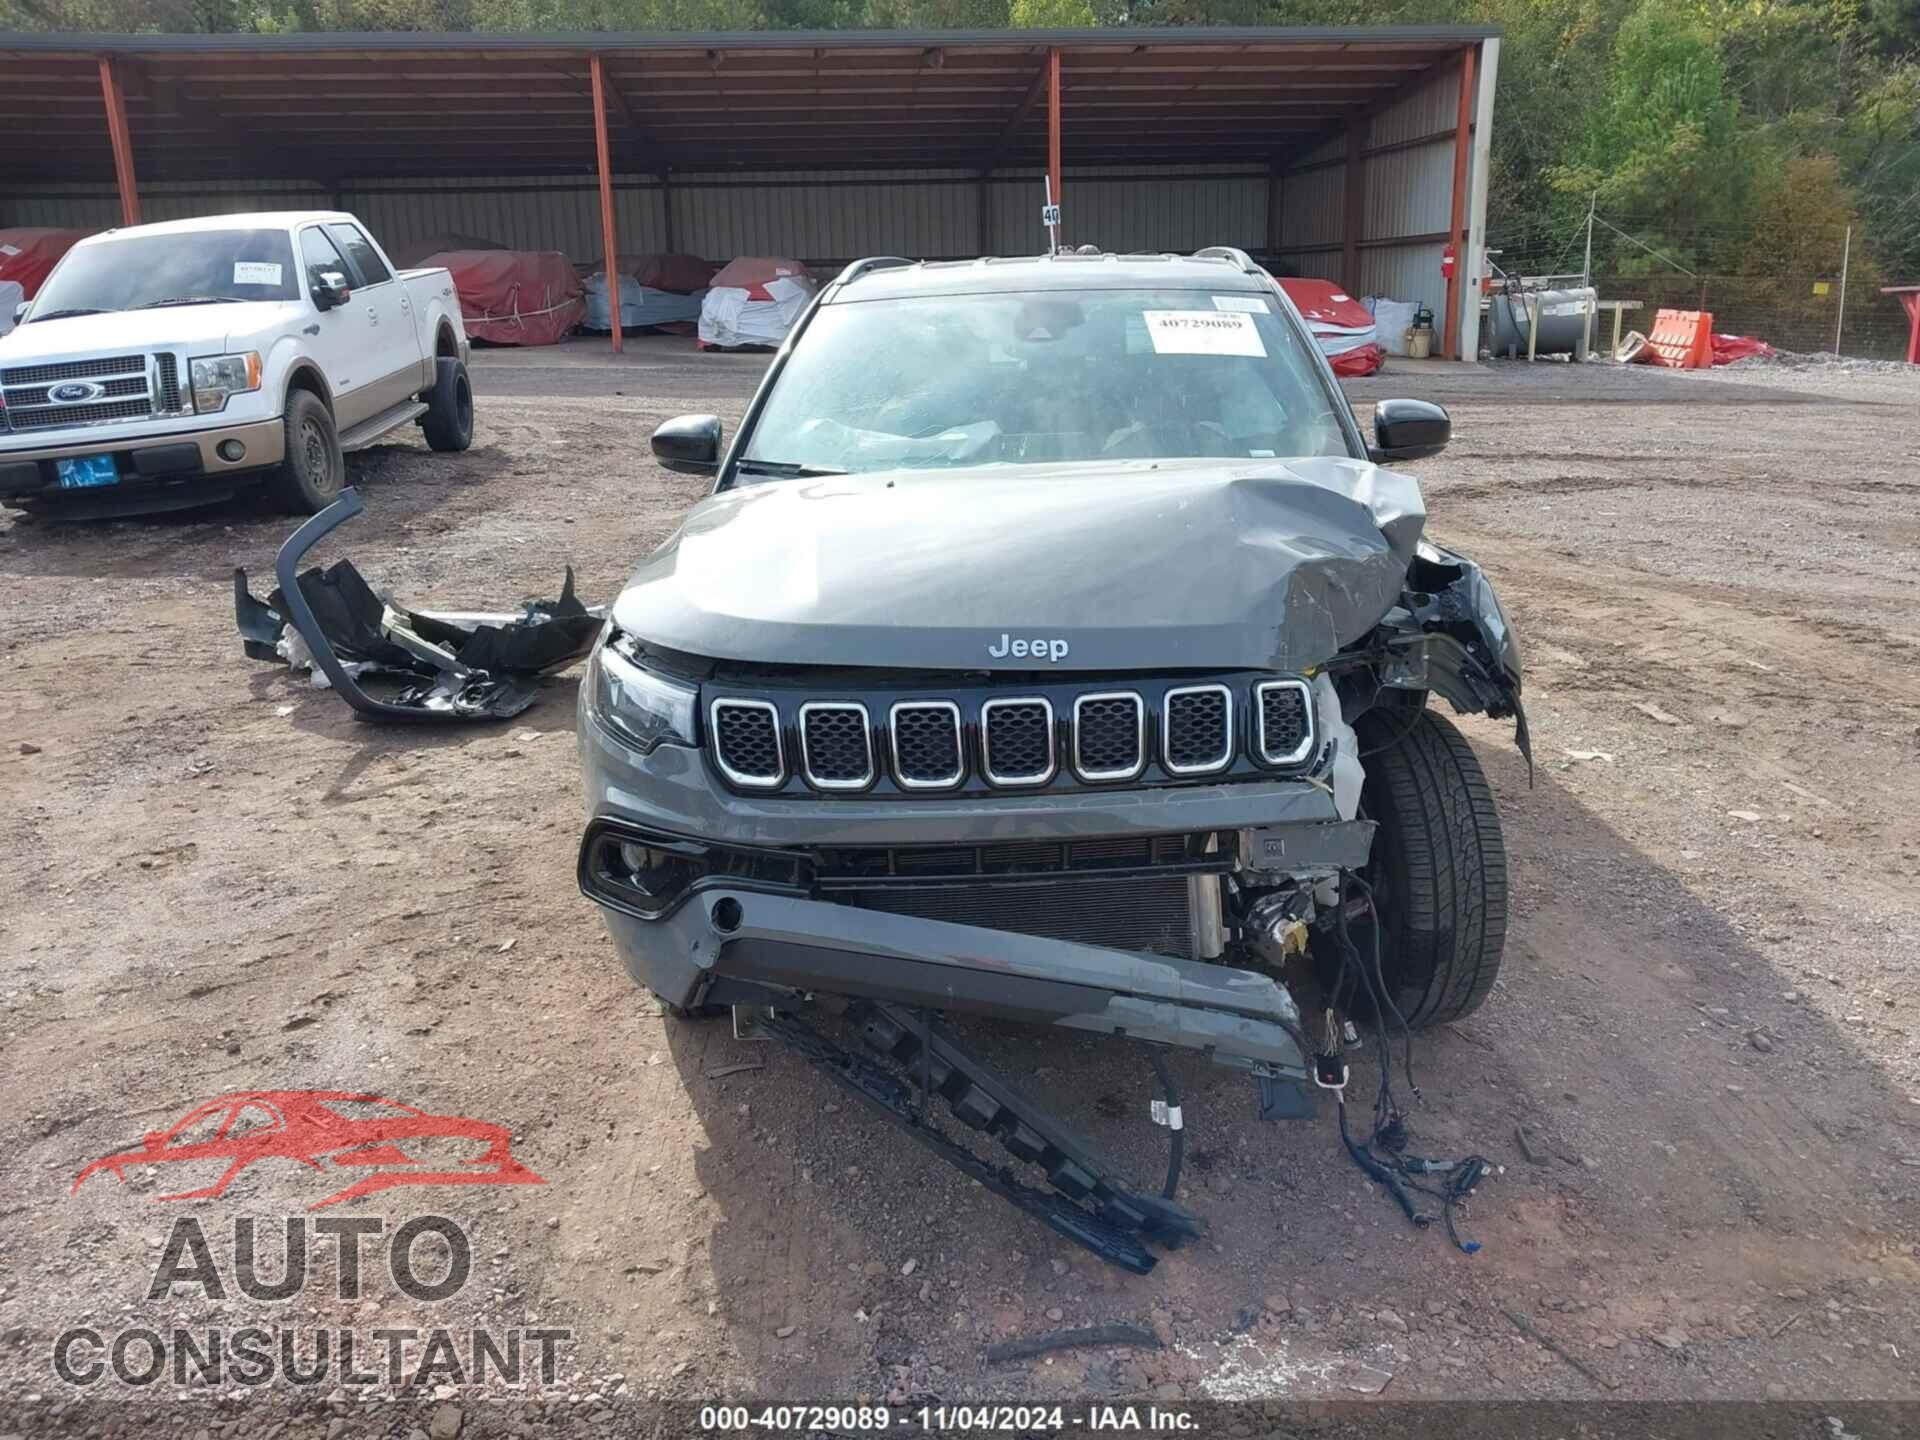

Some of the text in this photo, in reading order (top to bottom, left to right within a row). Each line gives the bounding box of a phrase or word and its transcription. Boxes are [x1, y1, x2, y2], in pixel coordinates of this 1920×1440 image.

[1044, 208, 1059, 222] 40
[1159, 319, 1243, 329] 40729089
[988, 633, 1069, 662] Jeep
